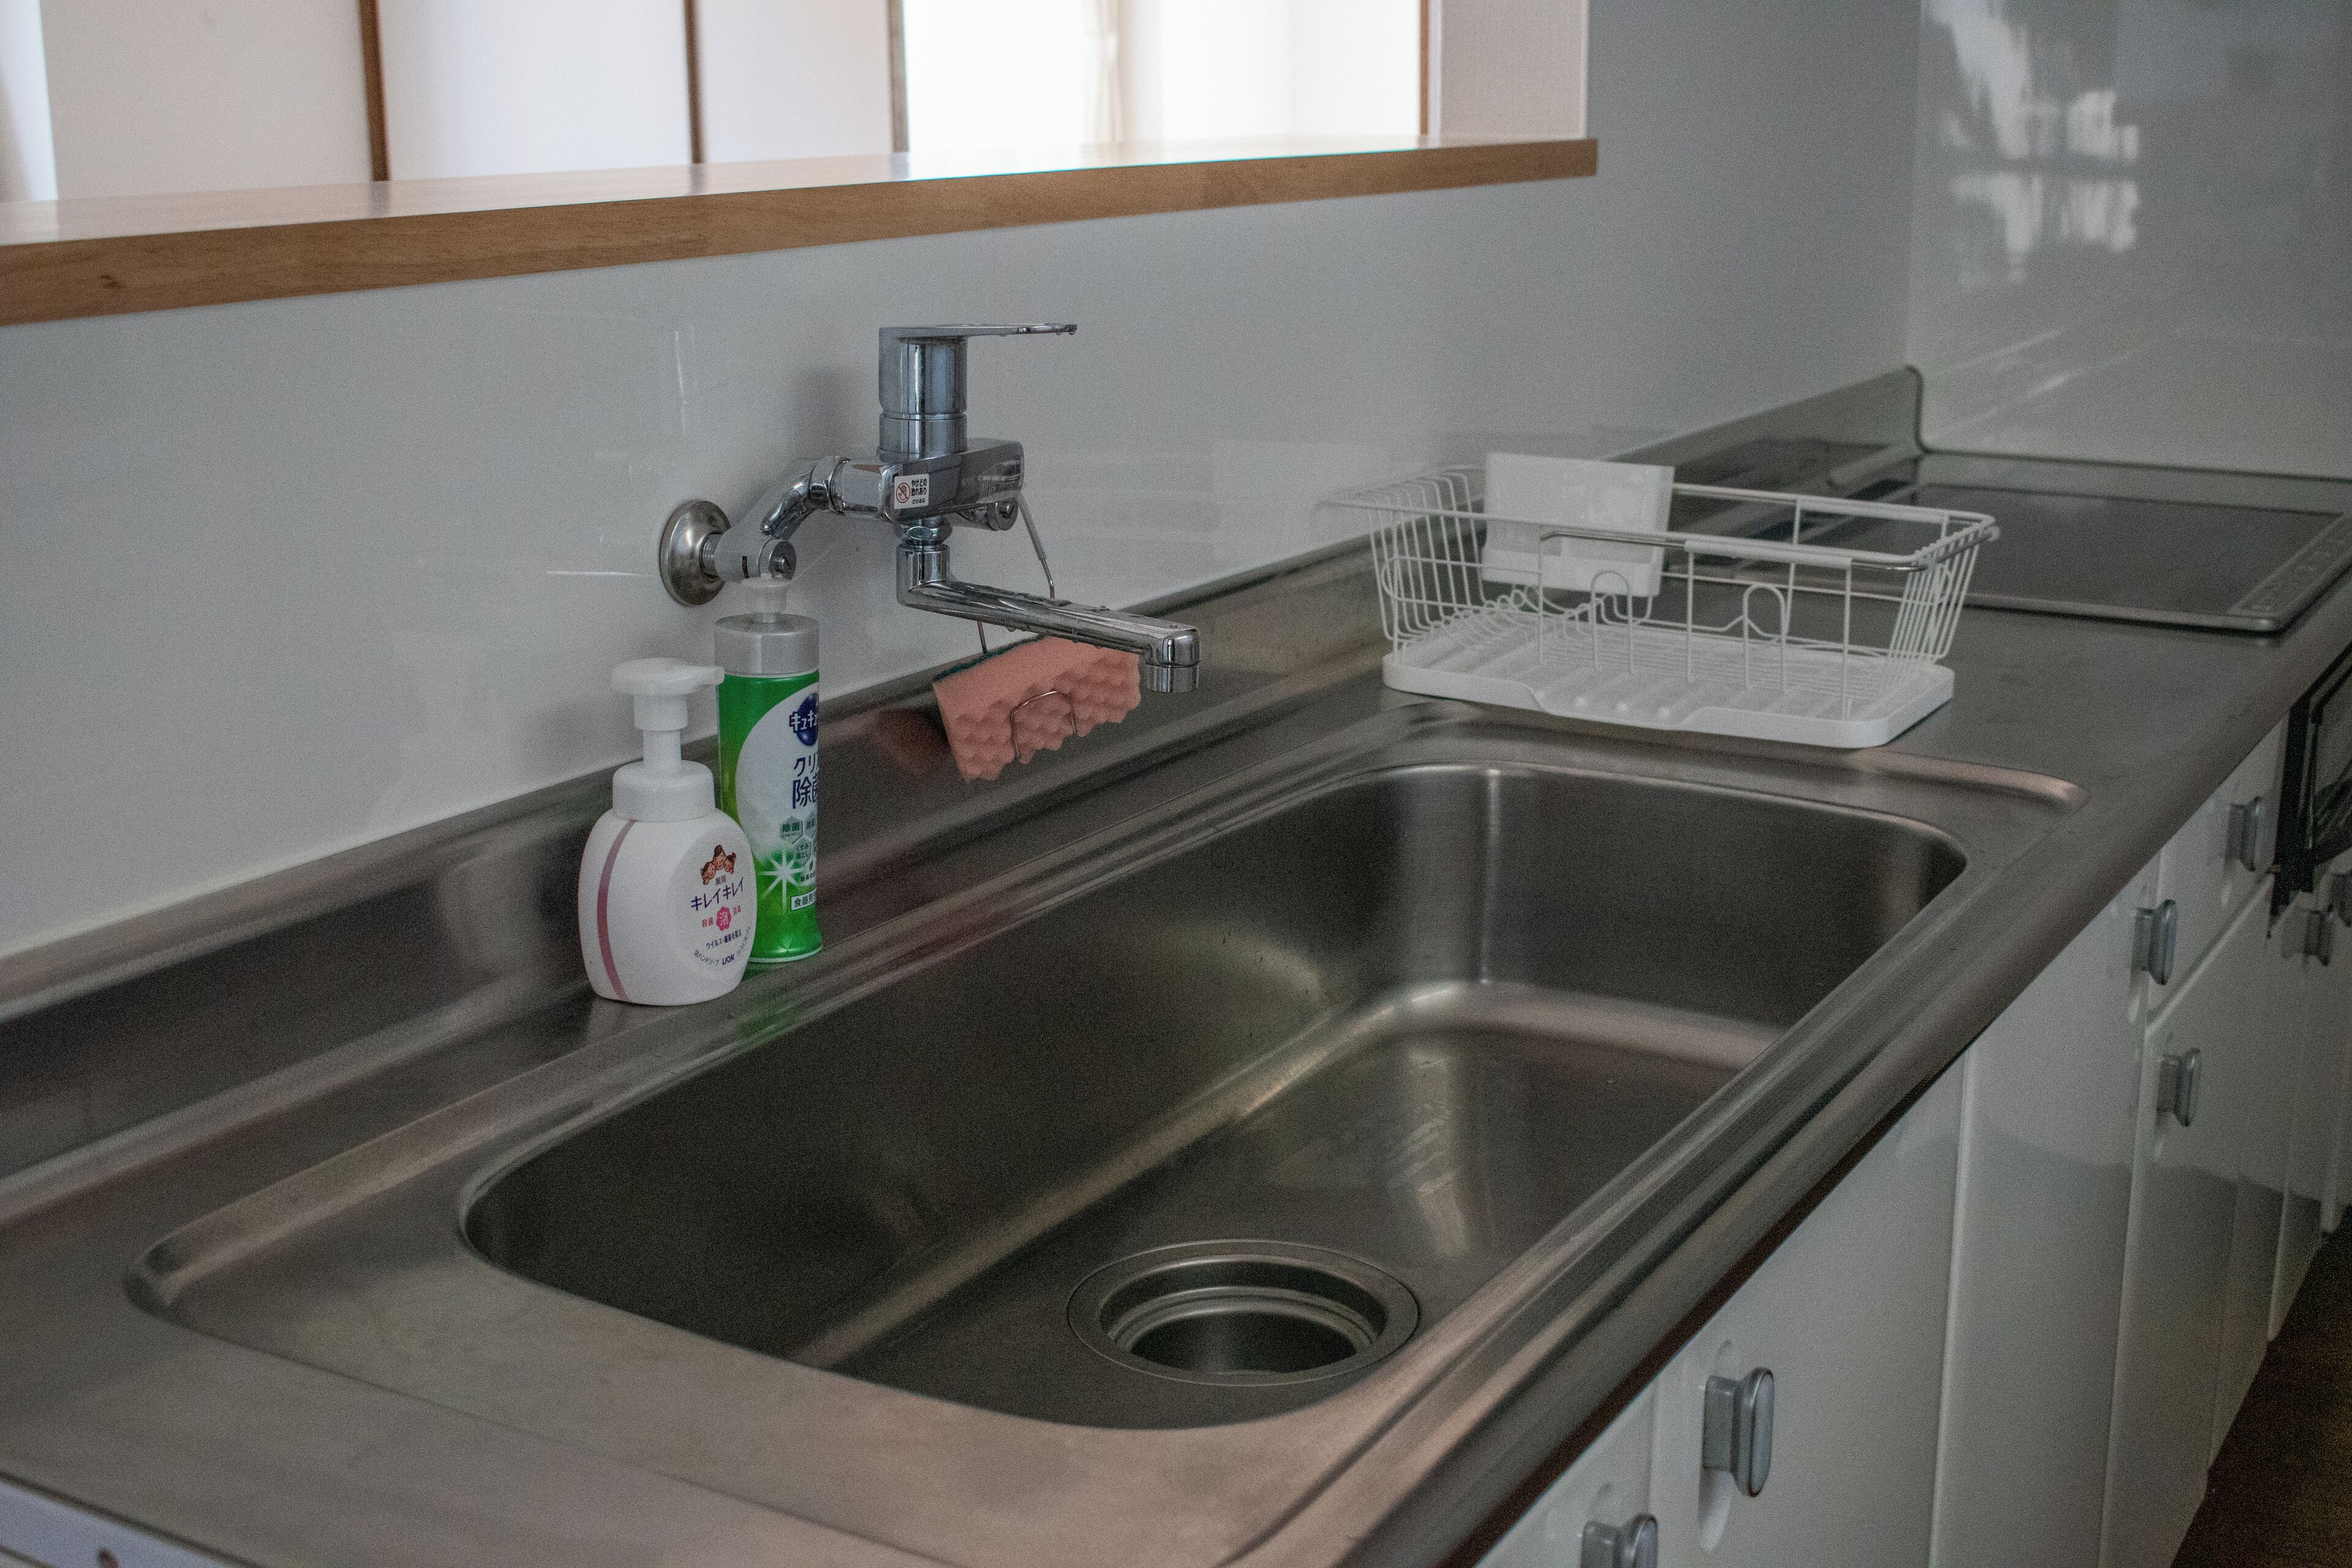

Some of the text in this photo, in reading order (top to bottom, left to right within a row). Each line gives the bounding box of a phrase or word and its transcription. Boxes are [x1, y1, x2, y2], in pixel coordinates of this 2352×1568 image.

[911, 478, 927, 488] やけどの
[691, 876, 744, 911] キレイキレイ
[722, 954, 734, 965] LION
